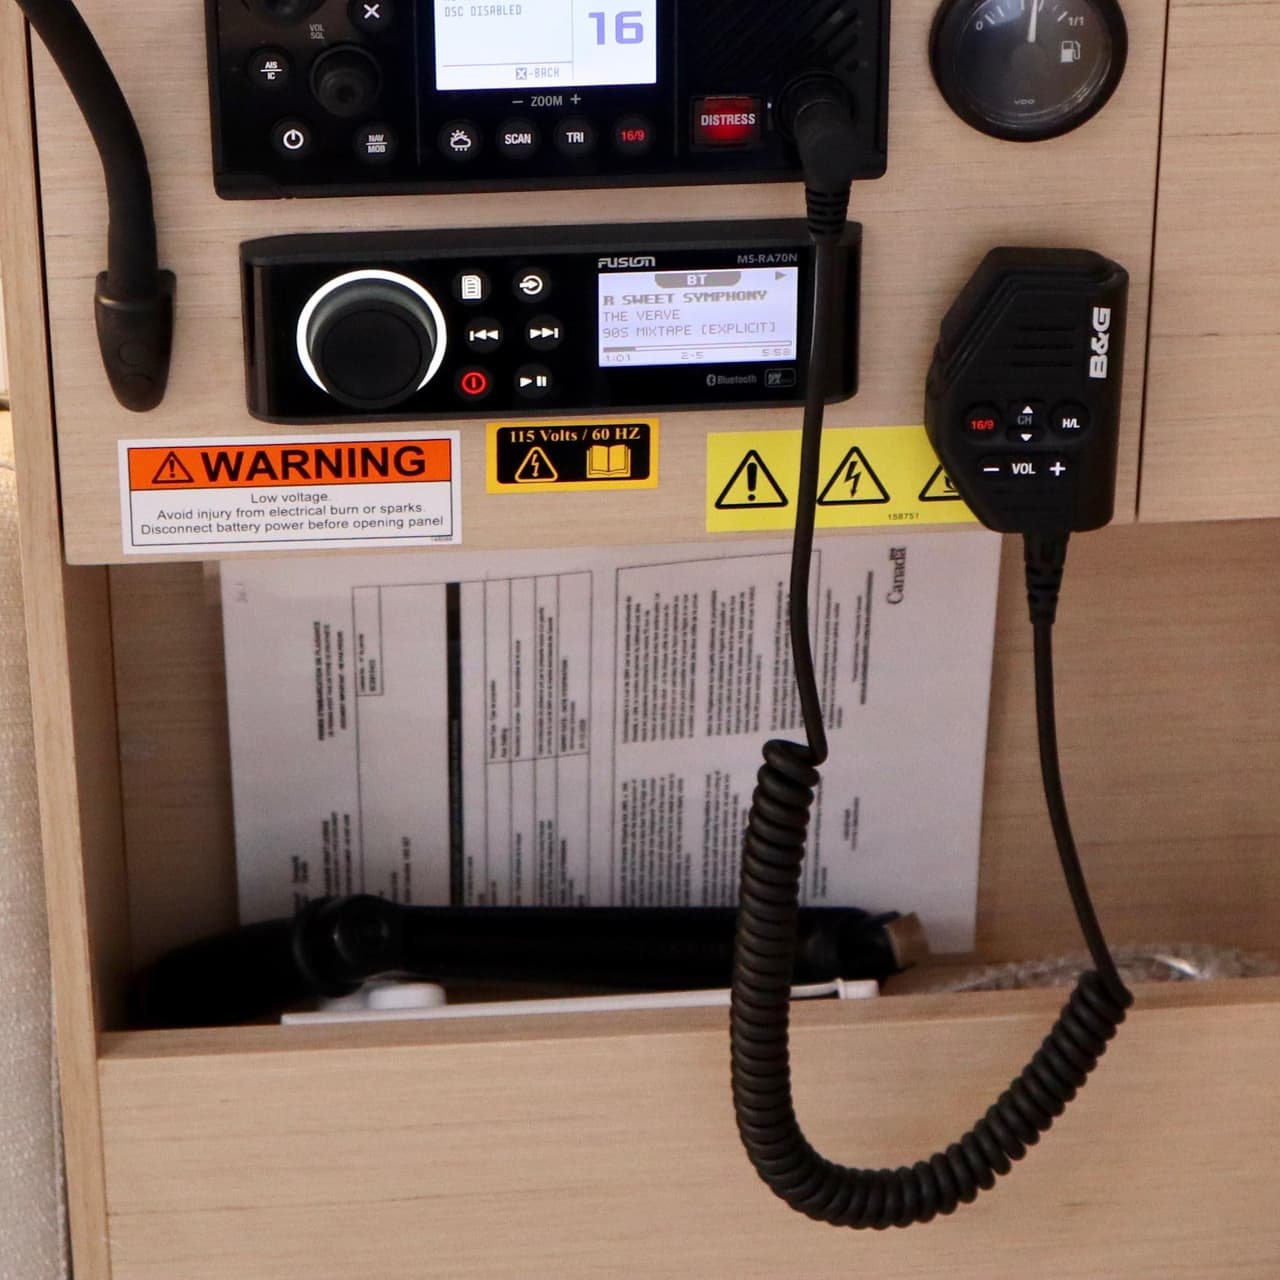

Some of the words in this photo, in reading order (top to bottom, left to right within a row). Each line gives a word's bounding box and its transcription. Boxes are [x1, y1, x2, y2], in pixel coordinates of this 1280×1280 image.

[470, 4, 522, 17] DISABLED
[588, 11, 644, 45] 16
[265, 61, 278, 69] AIS
[531, 96, 563, 107] ZOOM
[700, 112, 756, 127] DISTRESS
[504, 133, 531, 145] SCAN
[566, 132, 584, 144] TRI
[621, 129, 645, 143] 16/9
[737, 253, 798, 264] MS-RA70N
[687, 274, 708, 286] BT
[622, 293, 675, 306] SWEET
[683, 290, 768, 304] SYMPHONY
[603, 311, 629, 322] THE
[636, 309, 681, 321] VERVE
[636, 324, 693, 337] MIXTAPE
[1089, 307, 1111, 379] B&G
[971, 420, 994, 431] 16/9
[510, 430, 535, 443] 115
[540, 429, 578, 442] Volts
[592, 428, 610, 440] 60
[615, 427, 640, 440] HZ
[200, 445, 427, 483] WARNING
[1011, 463, 1036, 475] VOL
[251, 492, 279, 504] Low
[157, 509, 193, 521] Avoid
[197, 507, 232, 522] injury
[236, 506, 265, 519] from
[269, 504, 326, 517] electrical
[330, 503, 359, 515] burn
[363, 505, 376, 514] or
[141, 521, 214, 535] Disconnect
[216, 520, 261, 535] battery
[264, 519, 305, 534] power
[308, 517, 349, 531] before
[352, 516, 404, 532] opening
[886, 547, 907, 605] Canada
